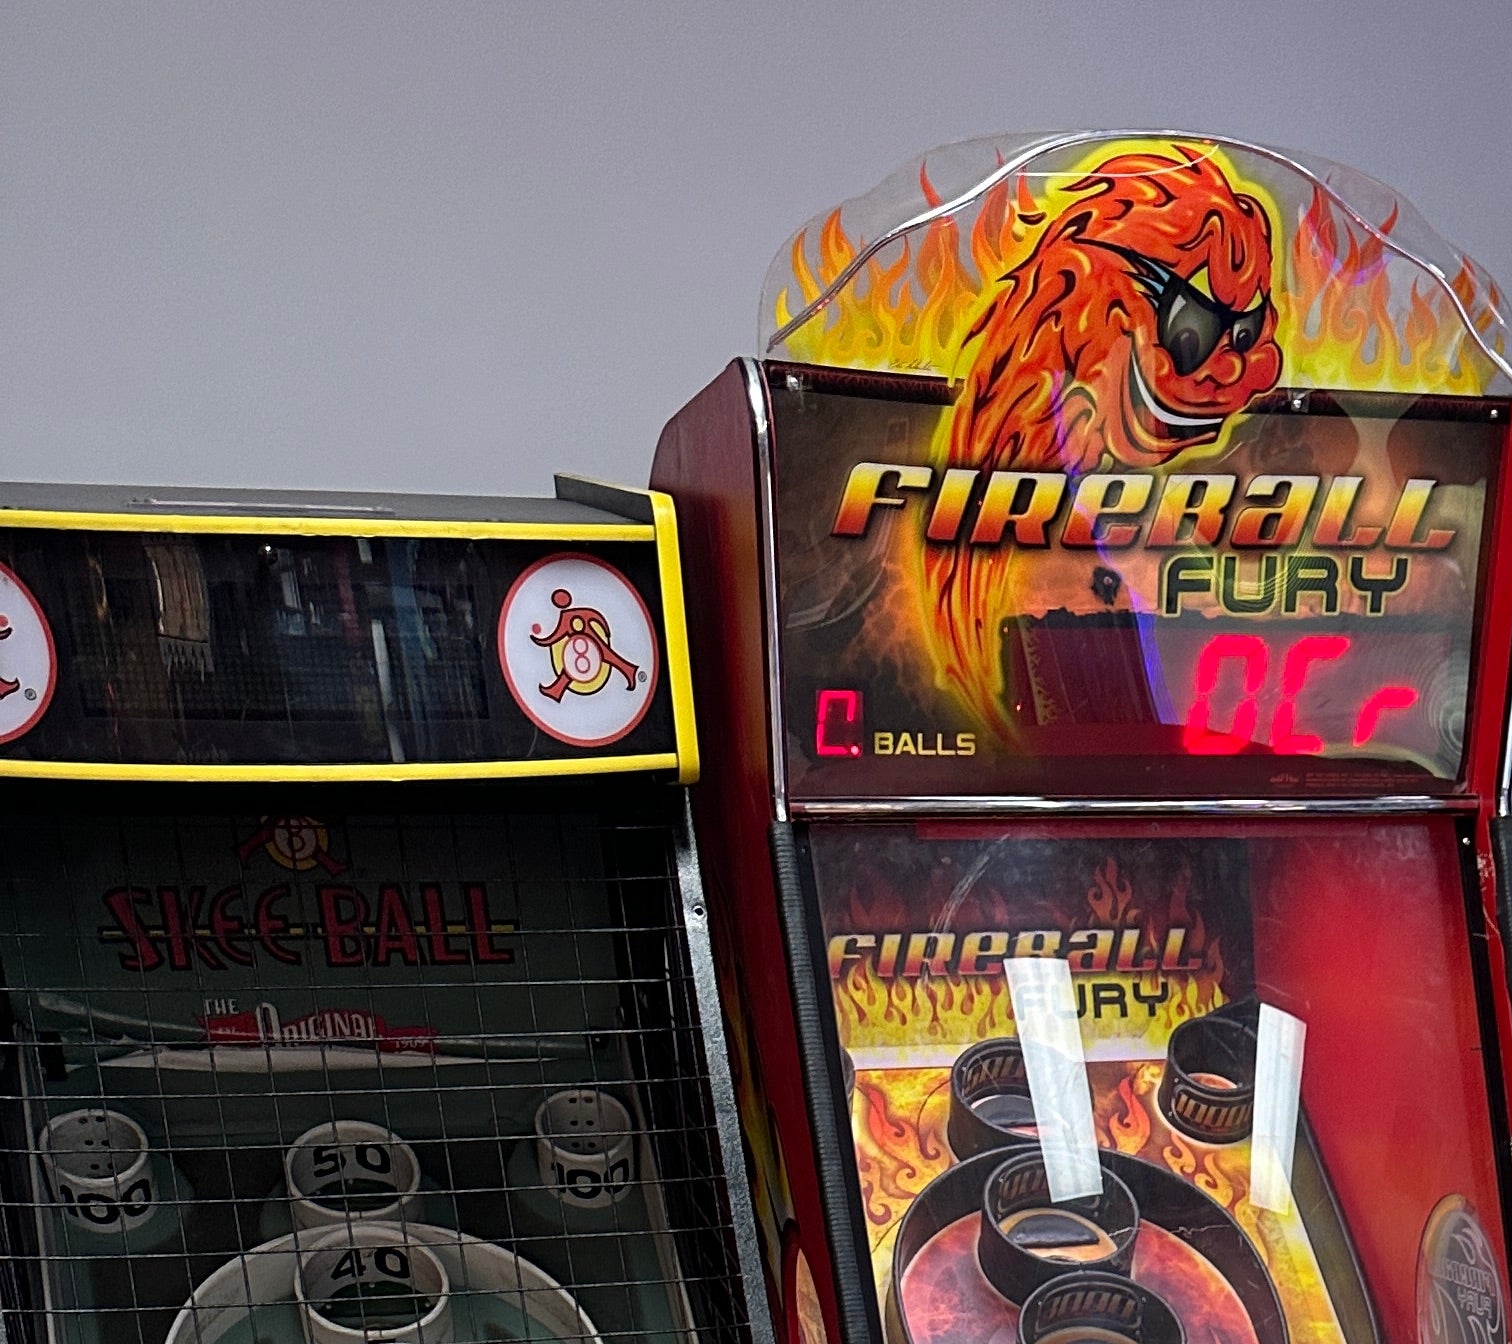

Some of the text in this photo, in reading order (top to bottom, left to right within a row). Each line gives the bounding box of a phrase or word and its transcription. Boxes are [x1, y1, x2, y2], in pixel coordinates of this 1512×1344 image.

[831, 462, 1457, 552] FIREBALL
[1159, 553, 1413, 617] FURY
[873, 731, 976, 757] BALLS
[828, 927, 1203, 979] FIREBALL
[312, 1145, 391, 1178] 50
[551, 1158, 630, 1200] 100
[60, 1178, 152, 1225] 100
[330, 1249, 411, 1281] 40
